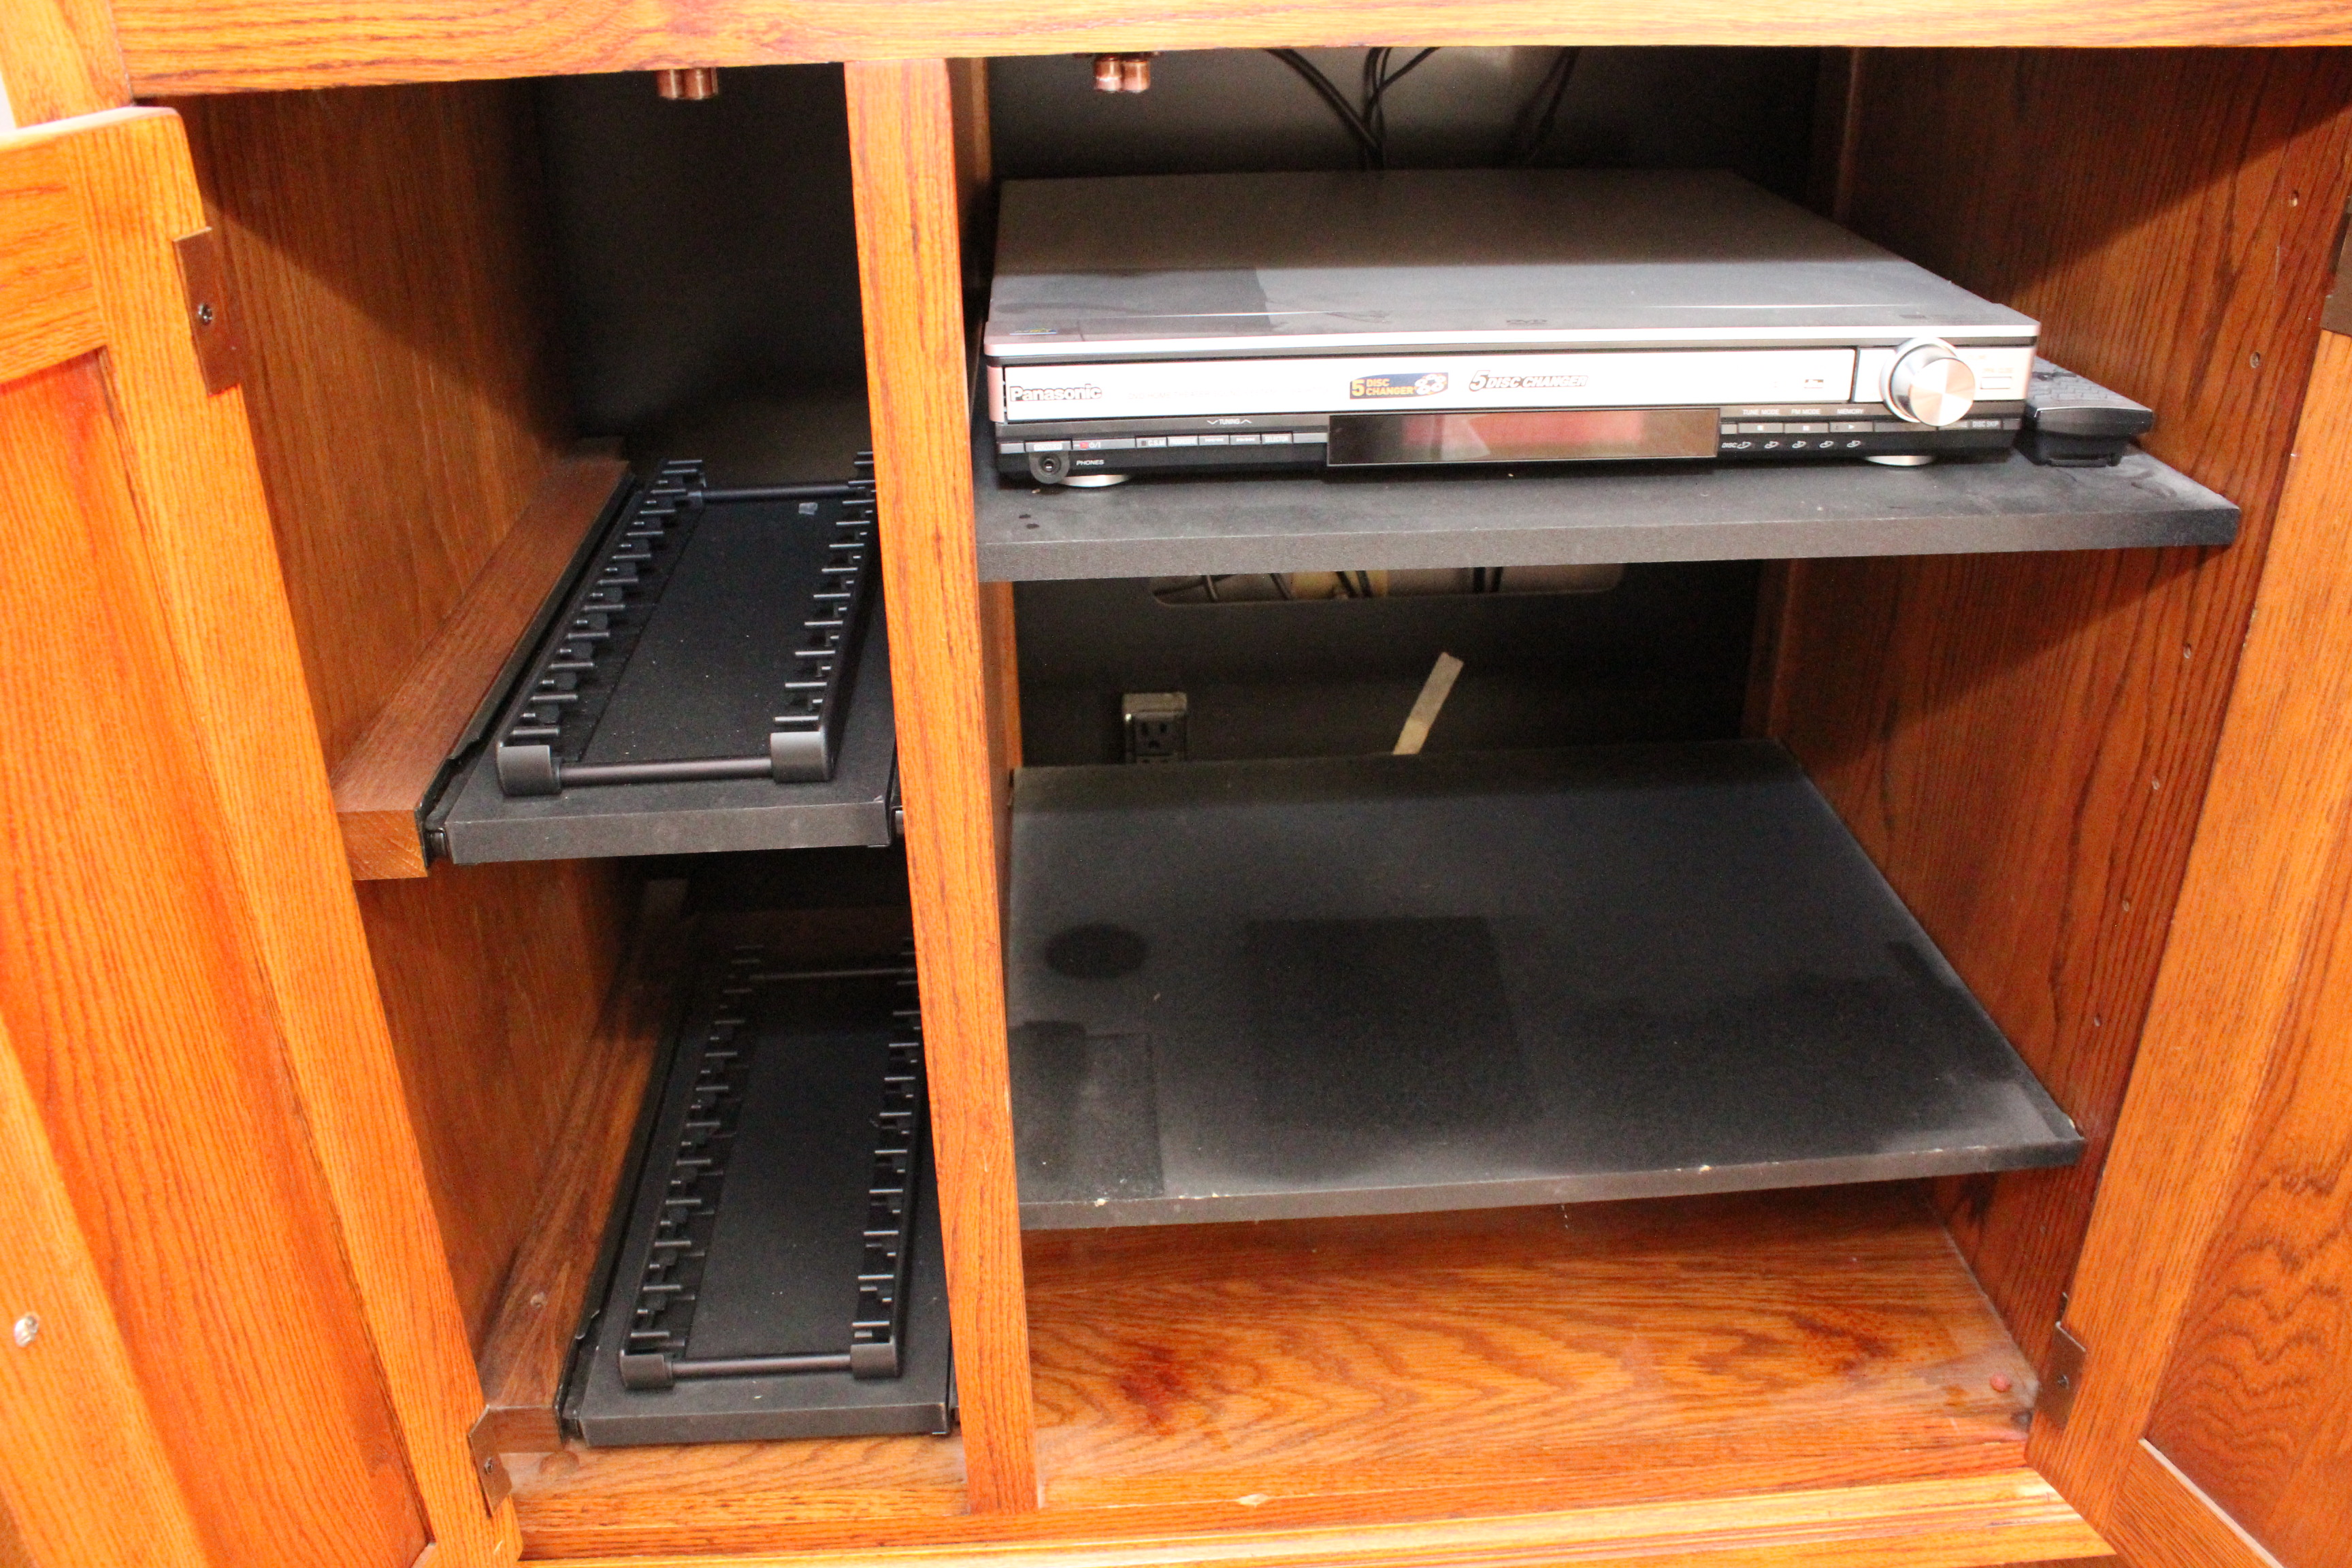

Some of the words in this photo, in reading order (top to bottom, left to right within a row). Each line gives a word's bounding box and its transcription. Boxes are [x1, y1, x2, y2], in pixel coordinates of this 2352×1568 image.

[1351, 380, 1365, 396] 5
[1365, 378, 1390, 387] DISC
[1469, 370, 1491, 392] 5
[1486, 376, 1522, 389] DISC
[1522, 375, 1589, 388] CHANGER
[1009, 383, 1102, 402] Panasonic
[1365, 386, 1415, 395] CHANGER
